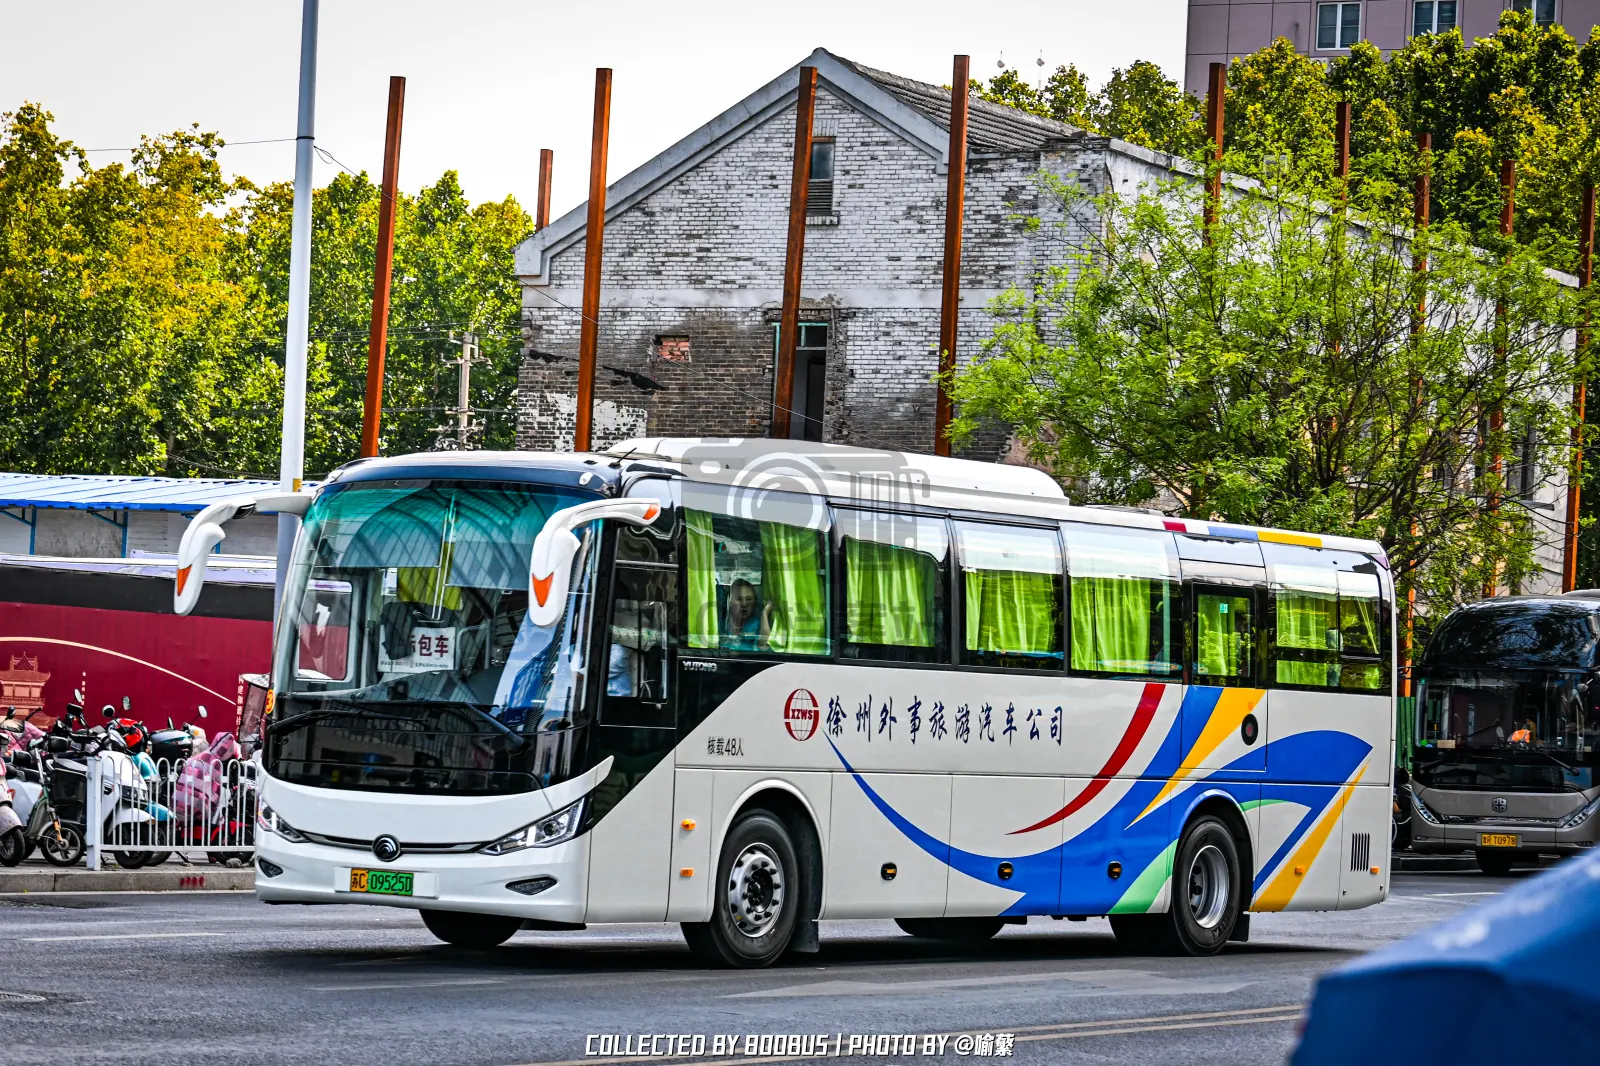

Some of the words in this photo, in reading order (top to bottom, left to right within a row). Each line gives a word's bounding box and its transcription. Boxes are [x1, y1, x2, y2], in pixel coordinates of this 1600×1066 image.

[682, 660, 717, 672] YUTONG
[790, 708, 813, 720] XZWS
[826, 694, 1063, 746] 徐州外事旅游汽车公司
[707, 736, 744, 756] 核载48人
